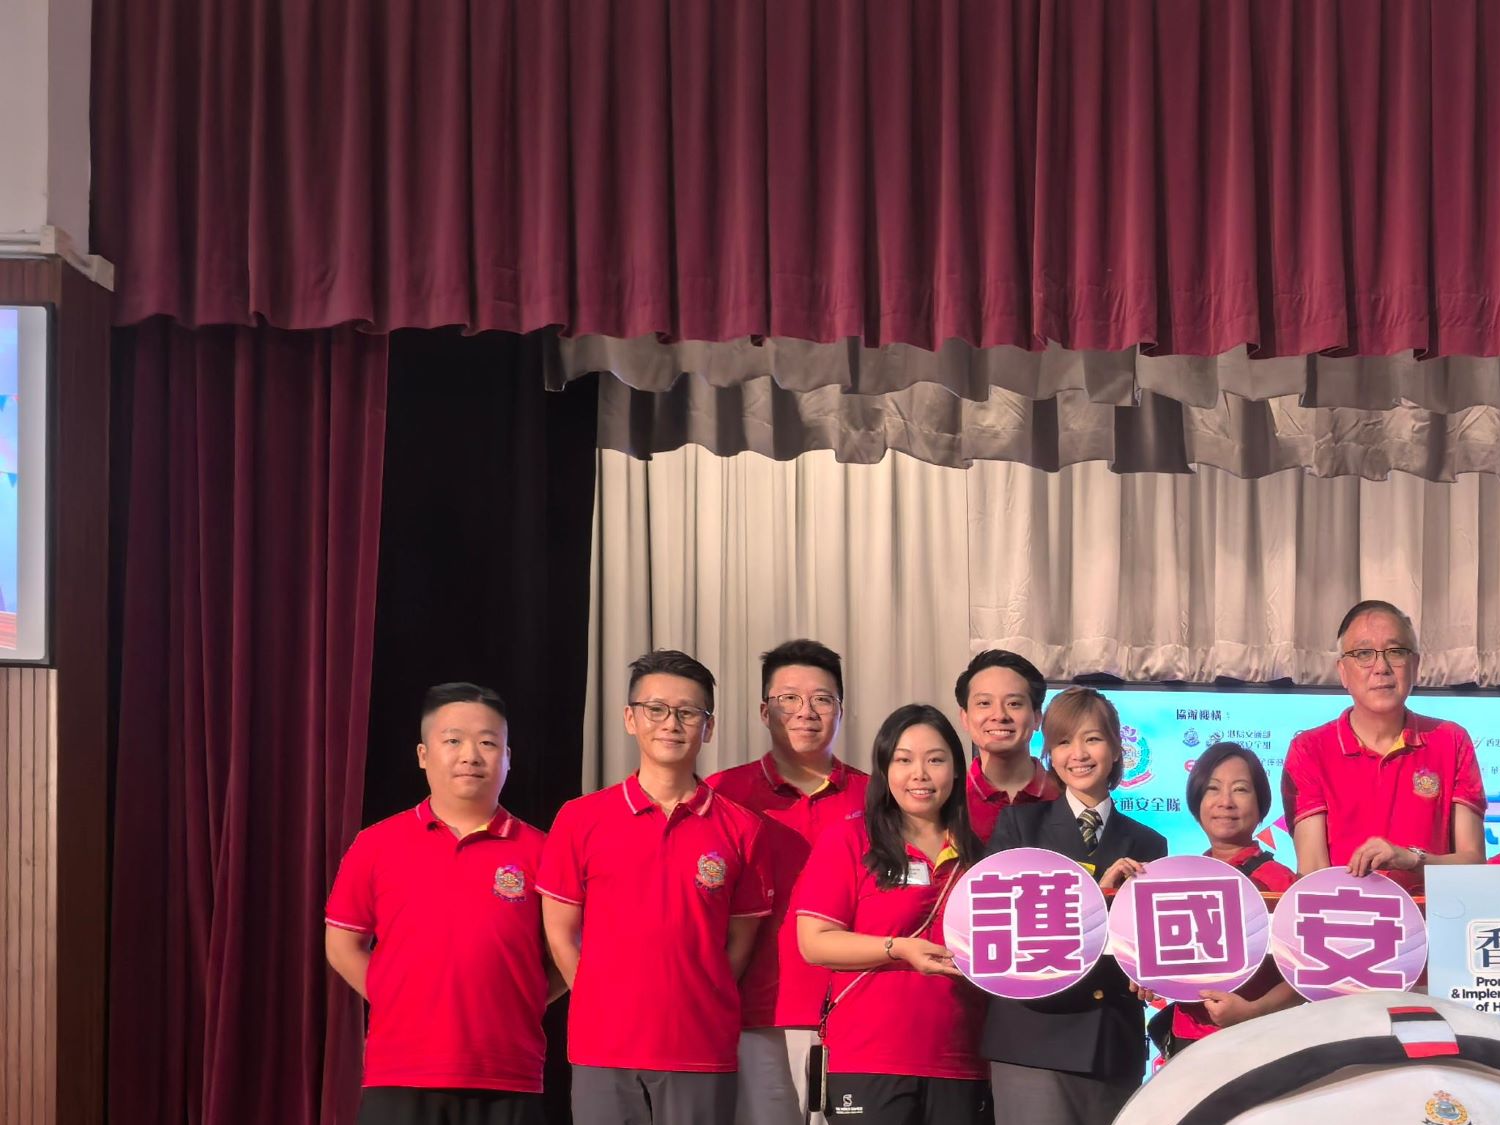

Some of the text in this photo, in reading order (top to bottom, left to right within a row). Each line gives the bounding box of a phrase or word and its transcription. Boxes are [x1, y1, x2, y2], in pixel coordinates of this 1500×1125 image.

[1114, 797, 1181, 812] 通安全隊
[969, 870, 1082, 976] 護
[1133, 877, 1247, 980] 國
[1295, 888, 1404, 990] 安
[1451, 989, 1461, 998] &
[1476, 1001, 1489, 1012] of
